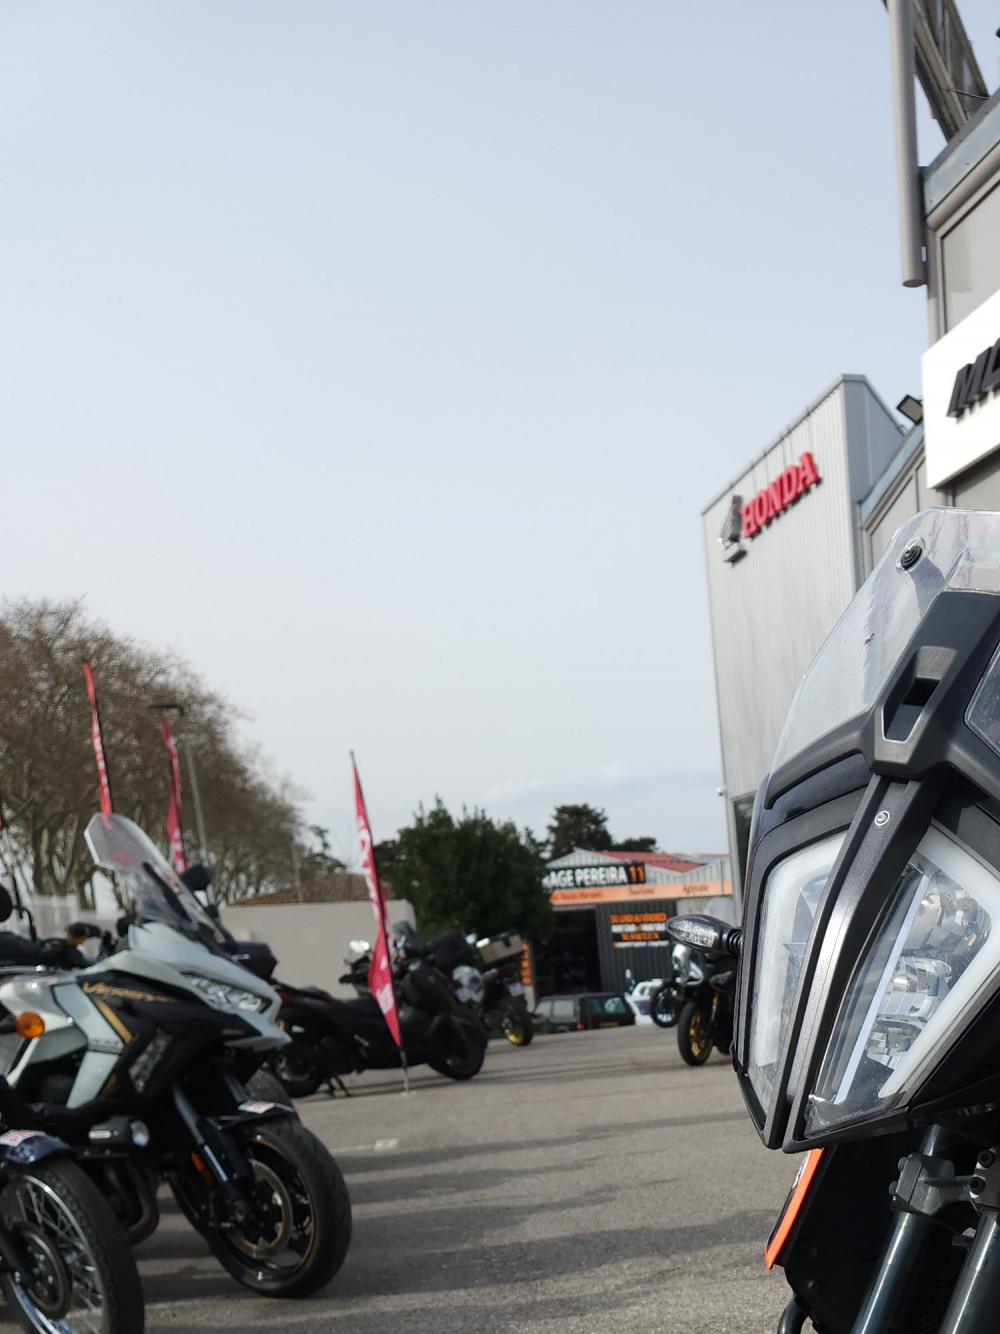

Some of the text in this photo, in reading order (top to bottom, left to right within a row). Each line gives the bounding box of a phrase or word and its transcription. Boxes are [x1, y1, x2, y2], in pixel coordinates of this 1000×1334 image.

[740, 451, 822, 540] HONDA
[575, 866, 628, 887] PEREIRA
[629, 865, 645, 883] 11
